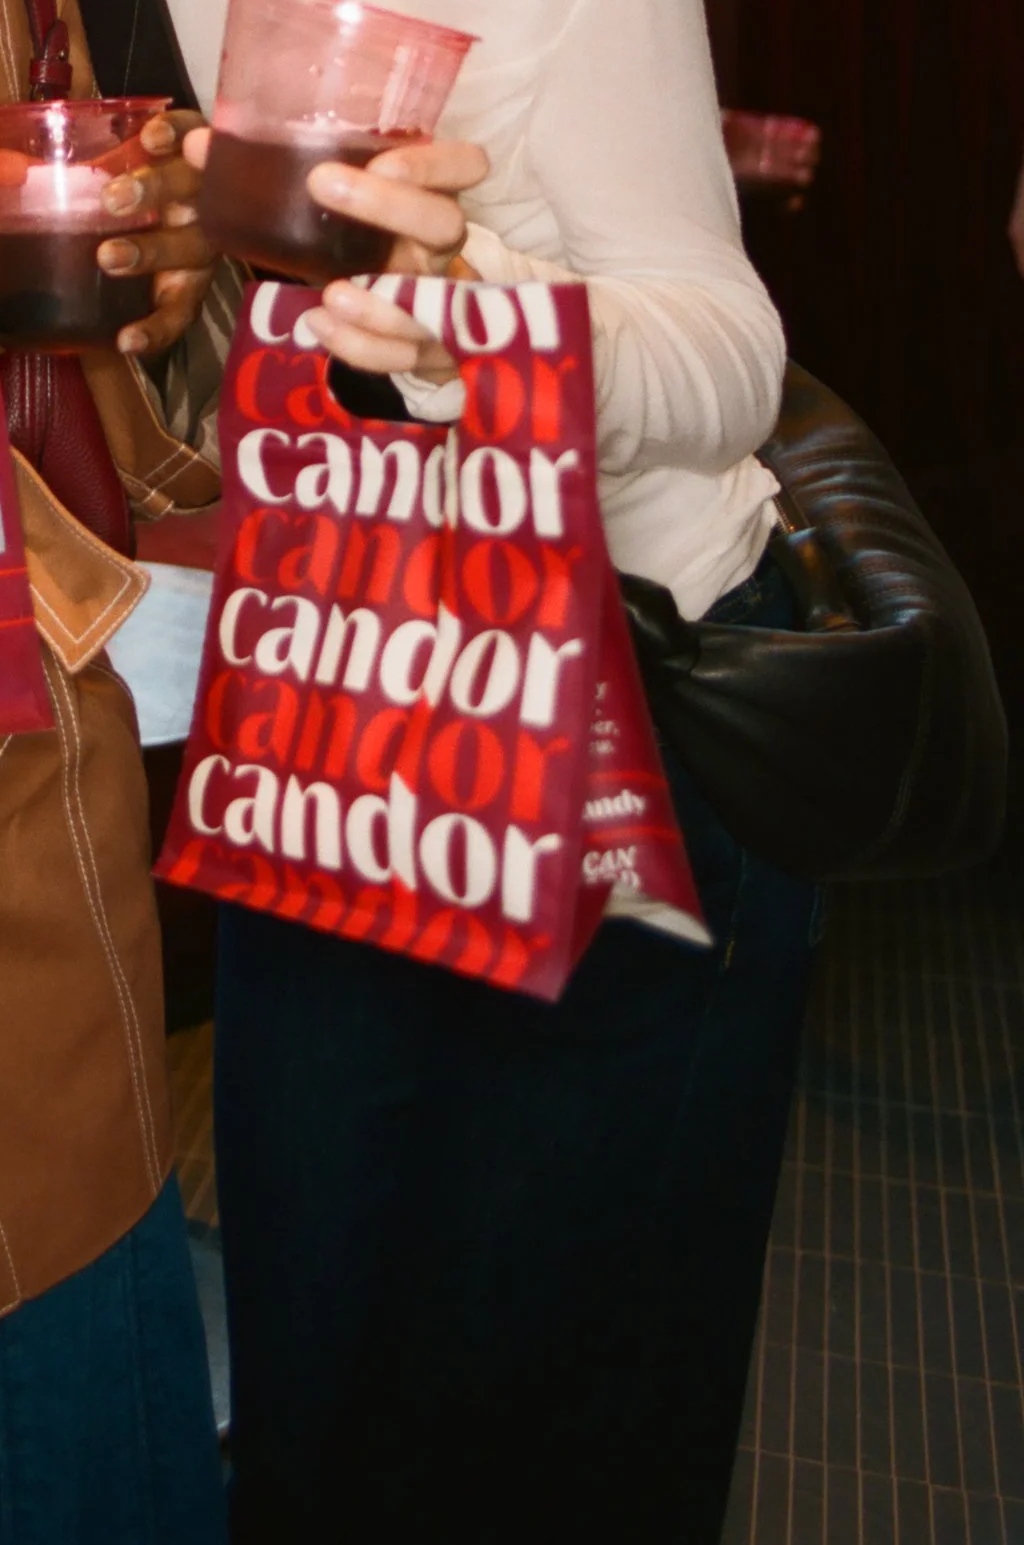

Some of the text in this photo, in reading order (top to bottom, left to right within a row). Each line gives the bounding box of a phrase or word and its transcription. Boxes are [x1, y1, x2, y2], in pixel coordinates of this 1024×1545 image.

[235, 347, 577, 442] caor
[237, 427, 577, 538] candor
[233, 508, 582, 629] candor
[219, 587, 582, 727] candor
[206, 670, 570, 821] candor
[188, 754, 563, 924] candor
